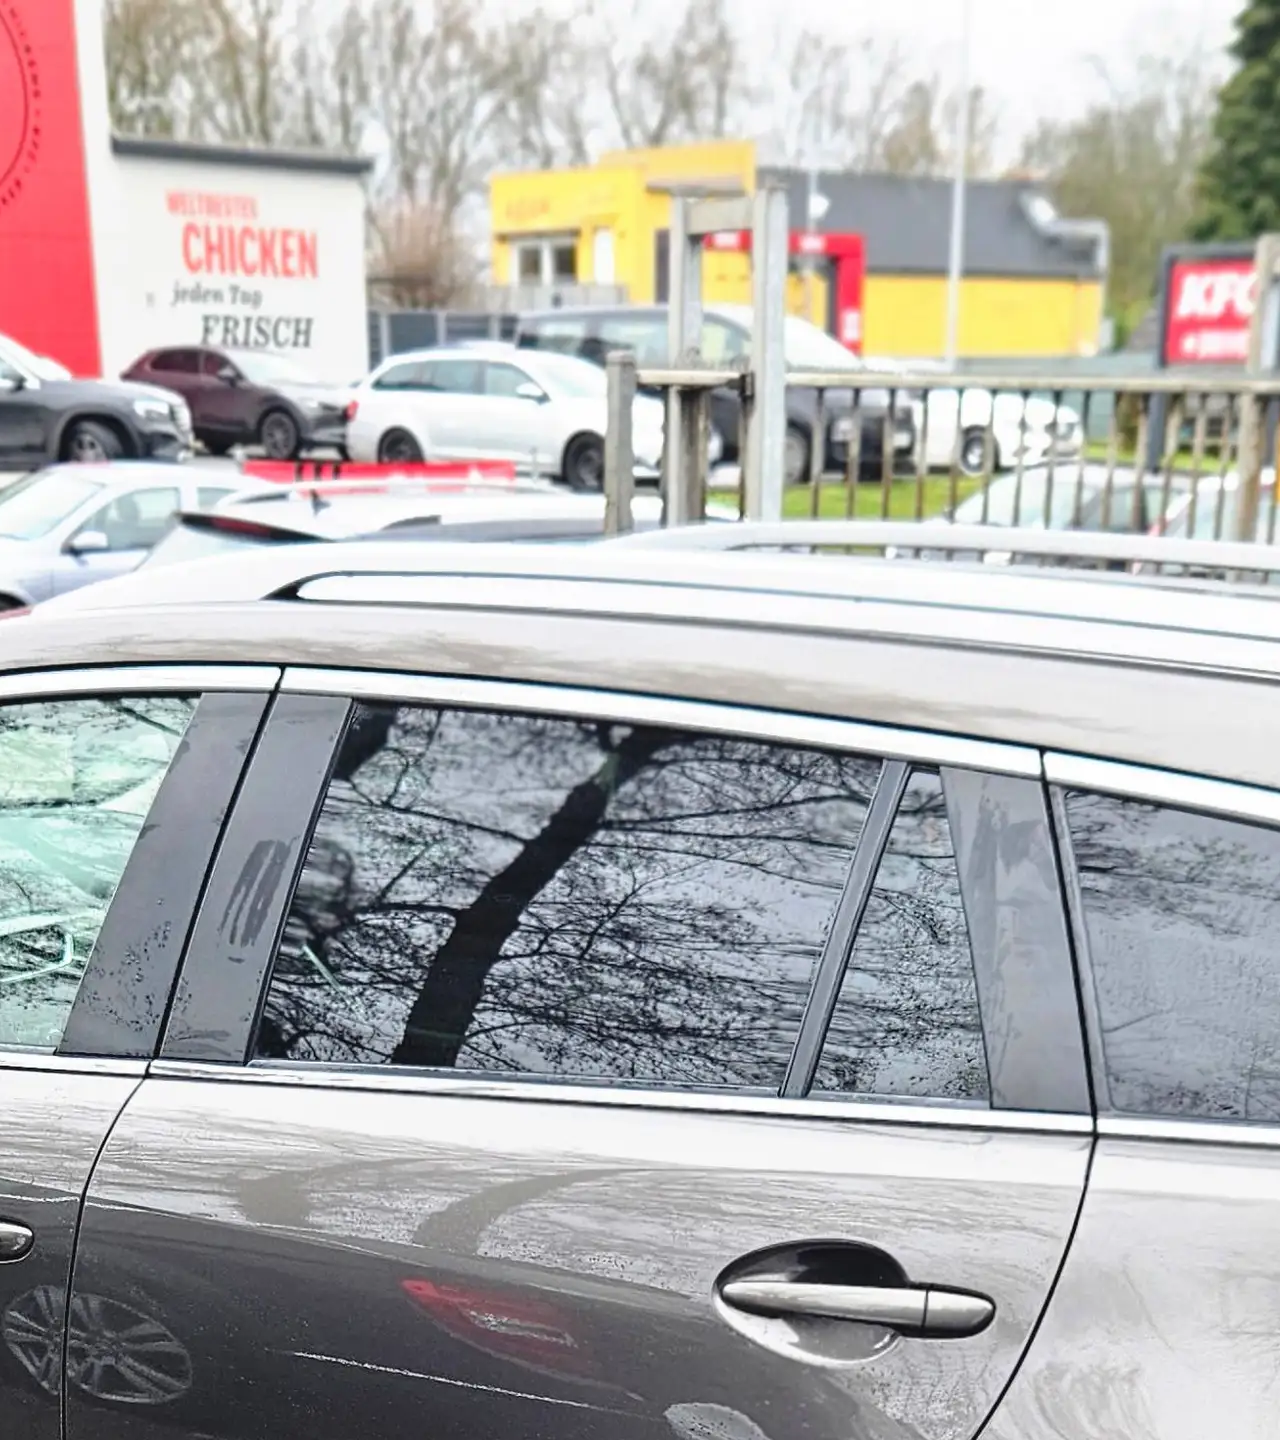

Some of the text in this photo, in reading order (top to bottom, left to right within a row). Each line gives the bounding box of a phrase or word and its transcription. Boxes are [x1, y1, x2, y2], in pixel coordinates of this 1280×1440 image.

[181, 221, 319, 280] CHICKEN
[171, 281, 263, 310] jeden Tag
[201, 313, 314, 349] FRISCH
